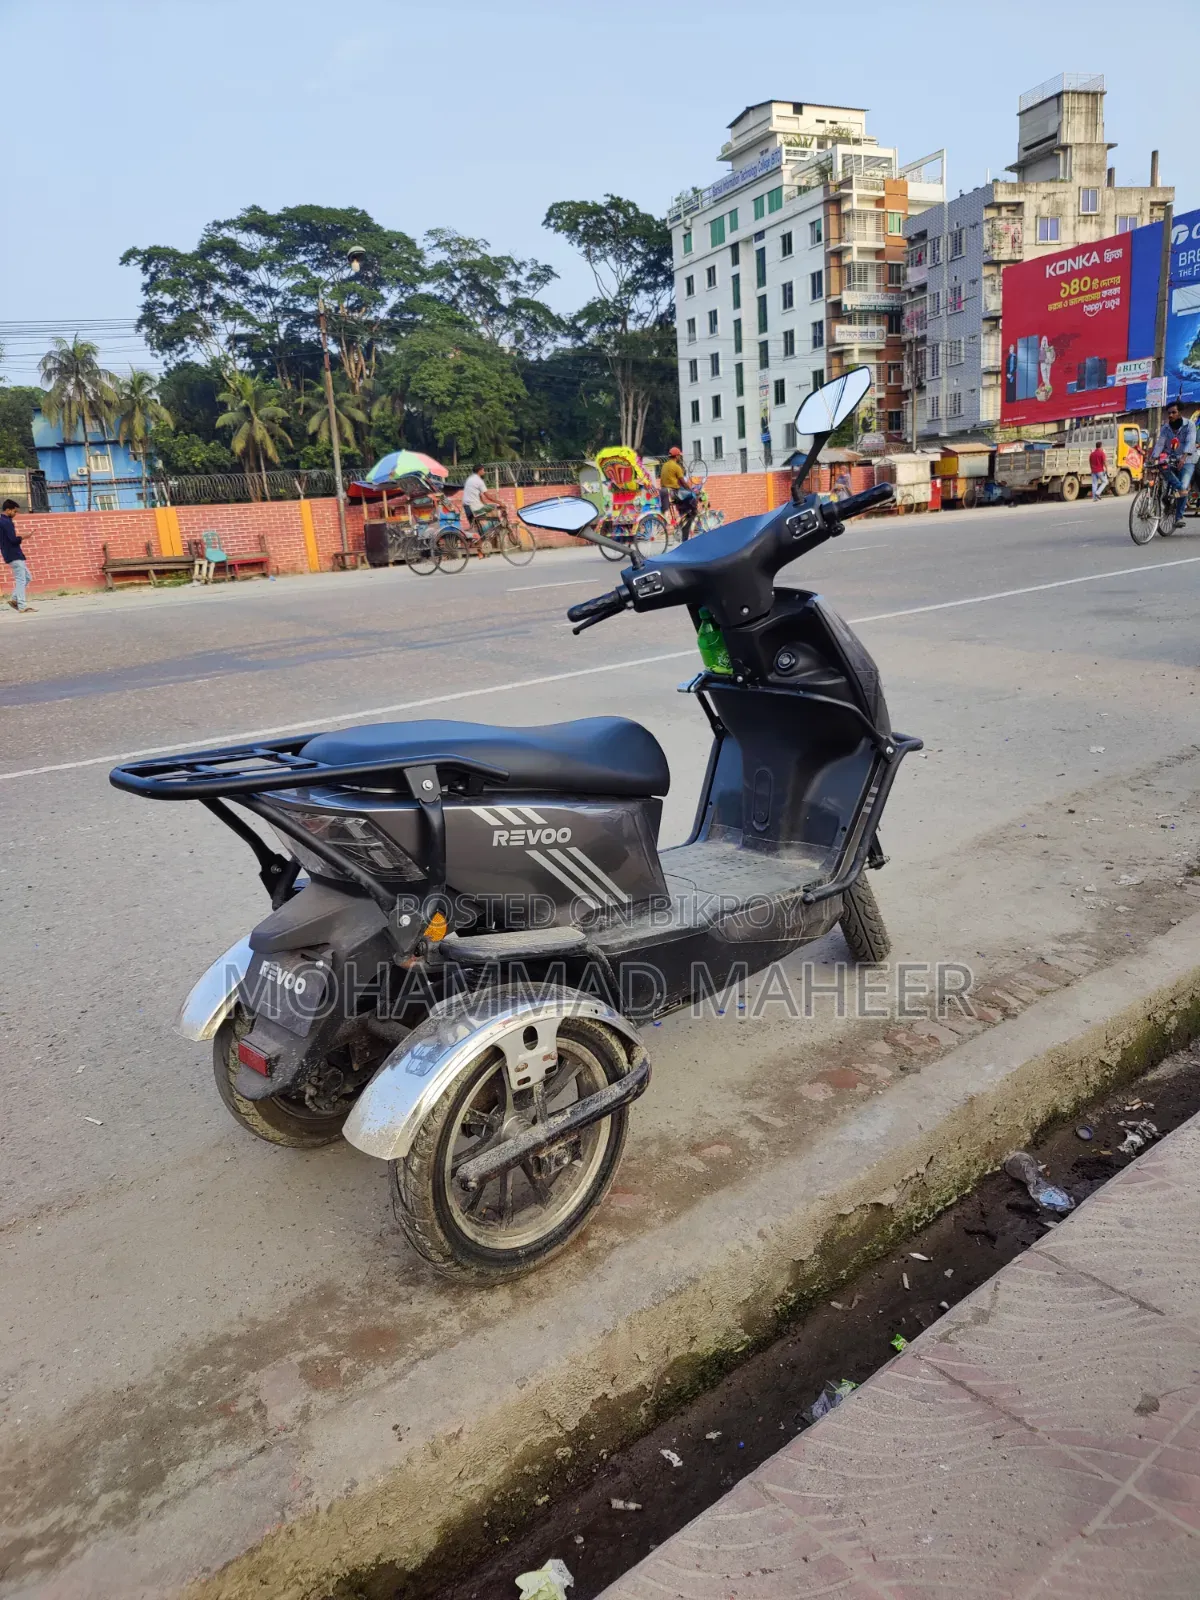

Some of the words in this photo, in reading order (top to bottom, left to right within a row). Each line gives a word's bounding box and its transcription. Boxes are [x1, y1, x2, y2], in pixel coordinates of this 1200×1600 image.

[723, 174, 740, 191] Information
[740, 163, 758, 181] Technology
[758, 157, 770, 173] College
[1045, 251, 1100, 278] KONKA
[859, 292, 880, 301] Program
[880, 292, 894, 301] Office
[1060, 276, 1091, 298] ১৪০
[1122, 361, 1146, 373] BITC
[492, 827, 572, 847] REVOO
[258, 960, 306, 995] REVOO
